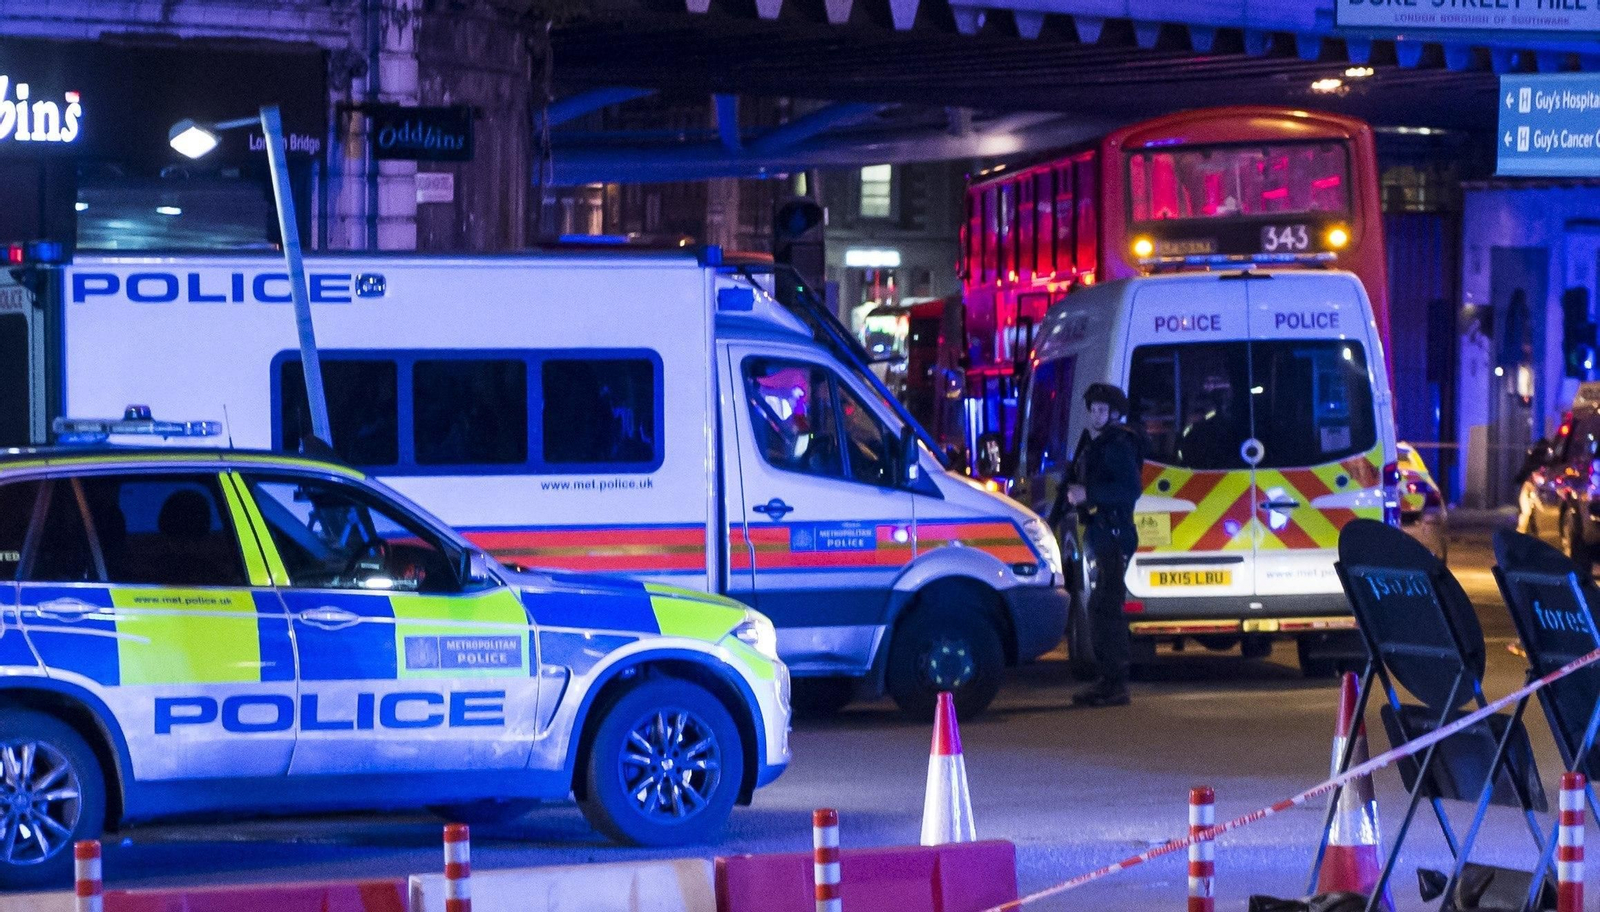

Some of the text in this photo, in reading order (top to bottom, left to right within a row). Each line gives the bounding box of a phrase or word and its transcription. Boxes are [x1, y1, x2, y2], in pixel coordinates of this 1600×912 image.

[1535, 90, 1560, 113] Guy's
[290, 132, 321, 155] Bridge
[378, 118, 465, 150] Oddbins
[1534, 129, 1559, 152] Guy's
[1560, 129, 1594, 148] Cancer
[1264, 225, 1309, 250] 343
[72, 273, 352, 303] POLICE
[1154, 314, 1222, 332] POLICE
[1274, 312, 1340, 329] POLICE
[540, 476, 654, 493] www.met.police.uk
[827, 538, 864, 548] POLICE
[133, 596, 232, 606] www.met.police.uk
[446, 640, 517, 651] METROPOLITAN
[457, 652, 508, 664] POLICE
[154, 690, 506, 735] POLICE
